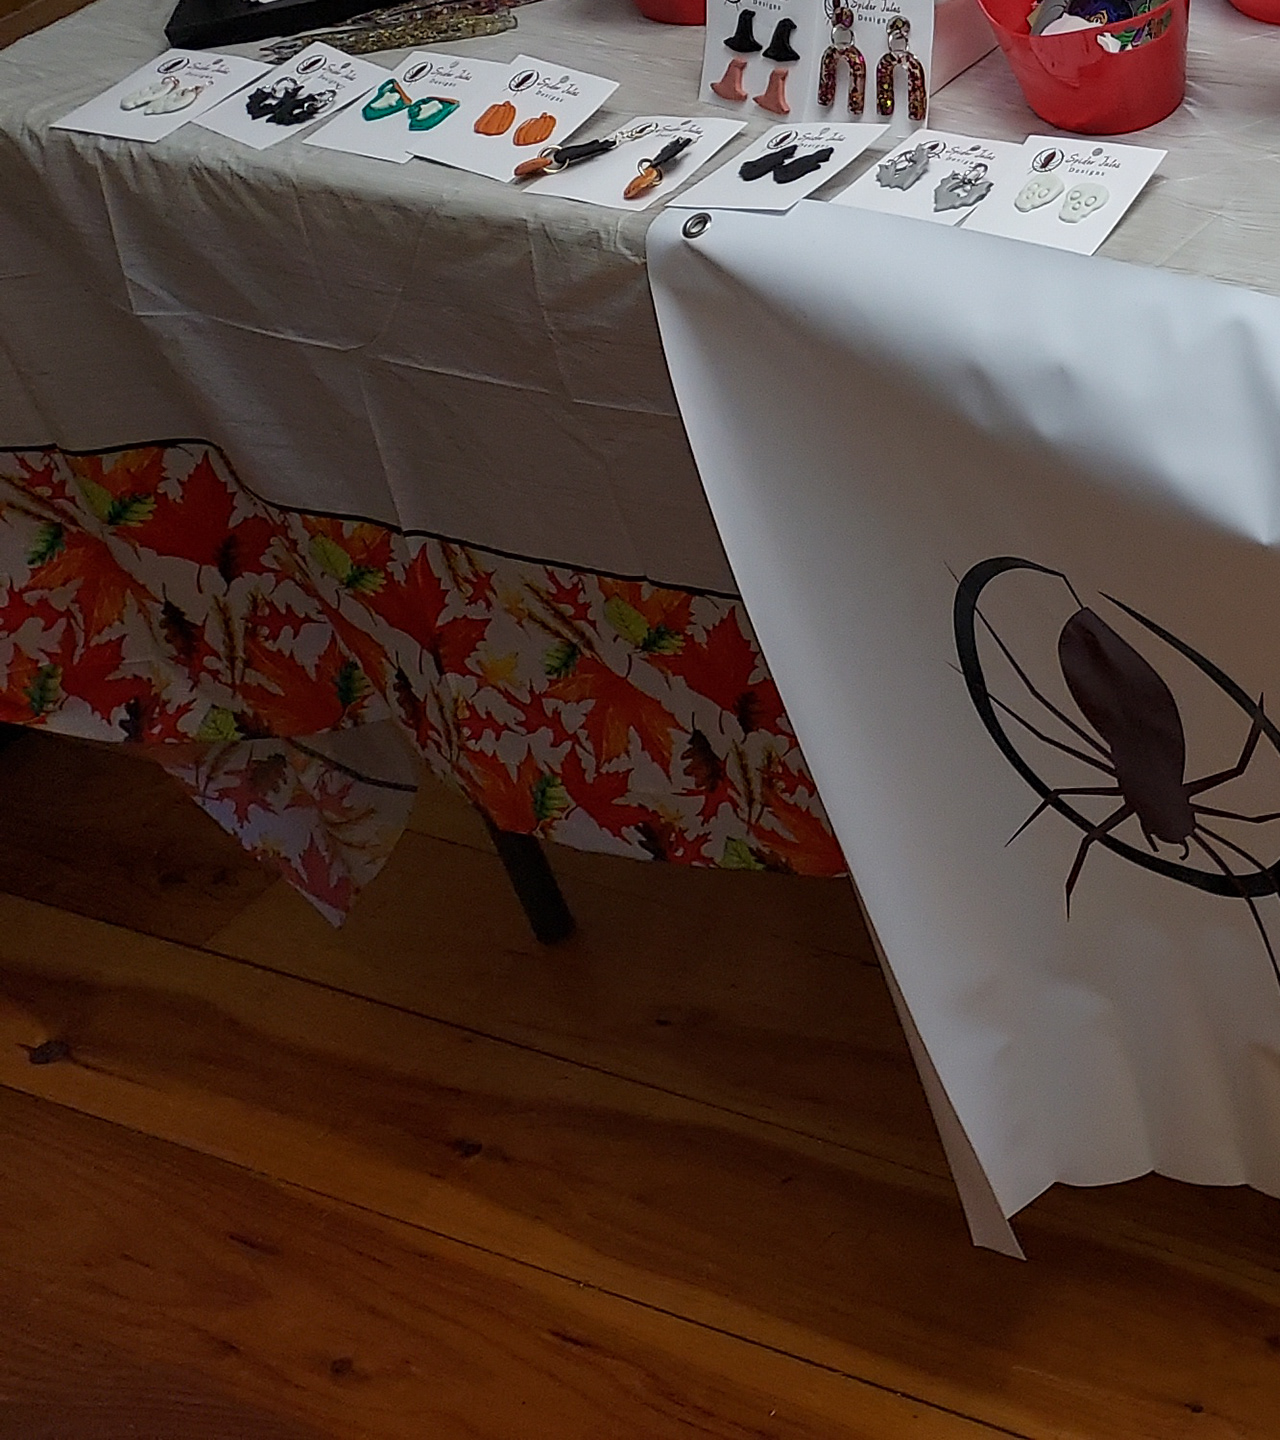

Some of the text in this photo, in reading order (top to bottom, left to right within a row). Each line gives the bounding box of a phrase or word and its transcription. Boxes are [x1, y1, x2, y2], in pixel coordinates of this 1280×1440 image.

[1064, 152, 1121, 169] Spider Jules
[1068, 166, 1105, 177] Designs
